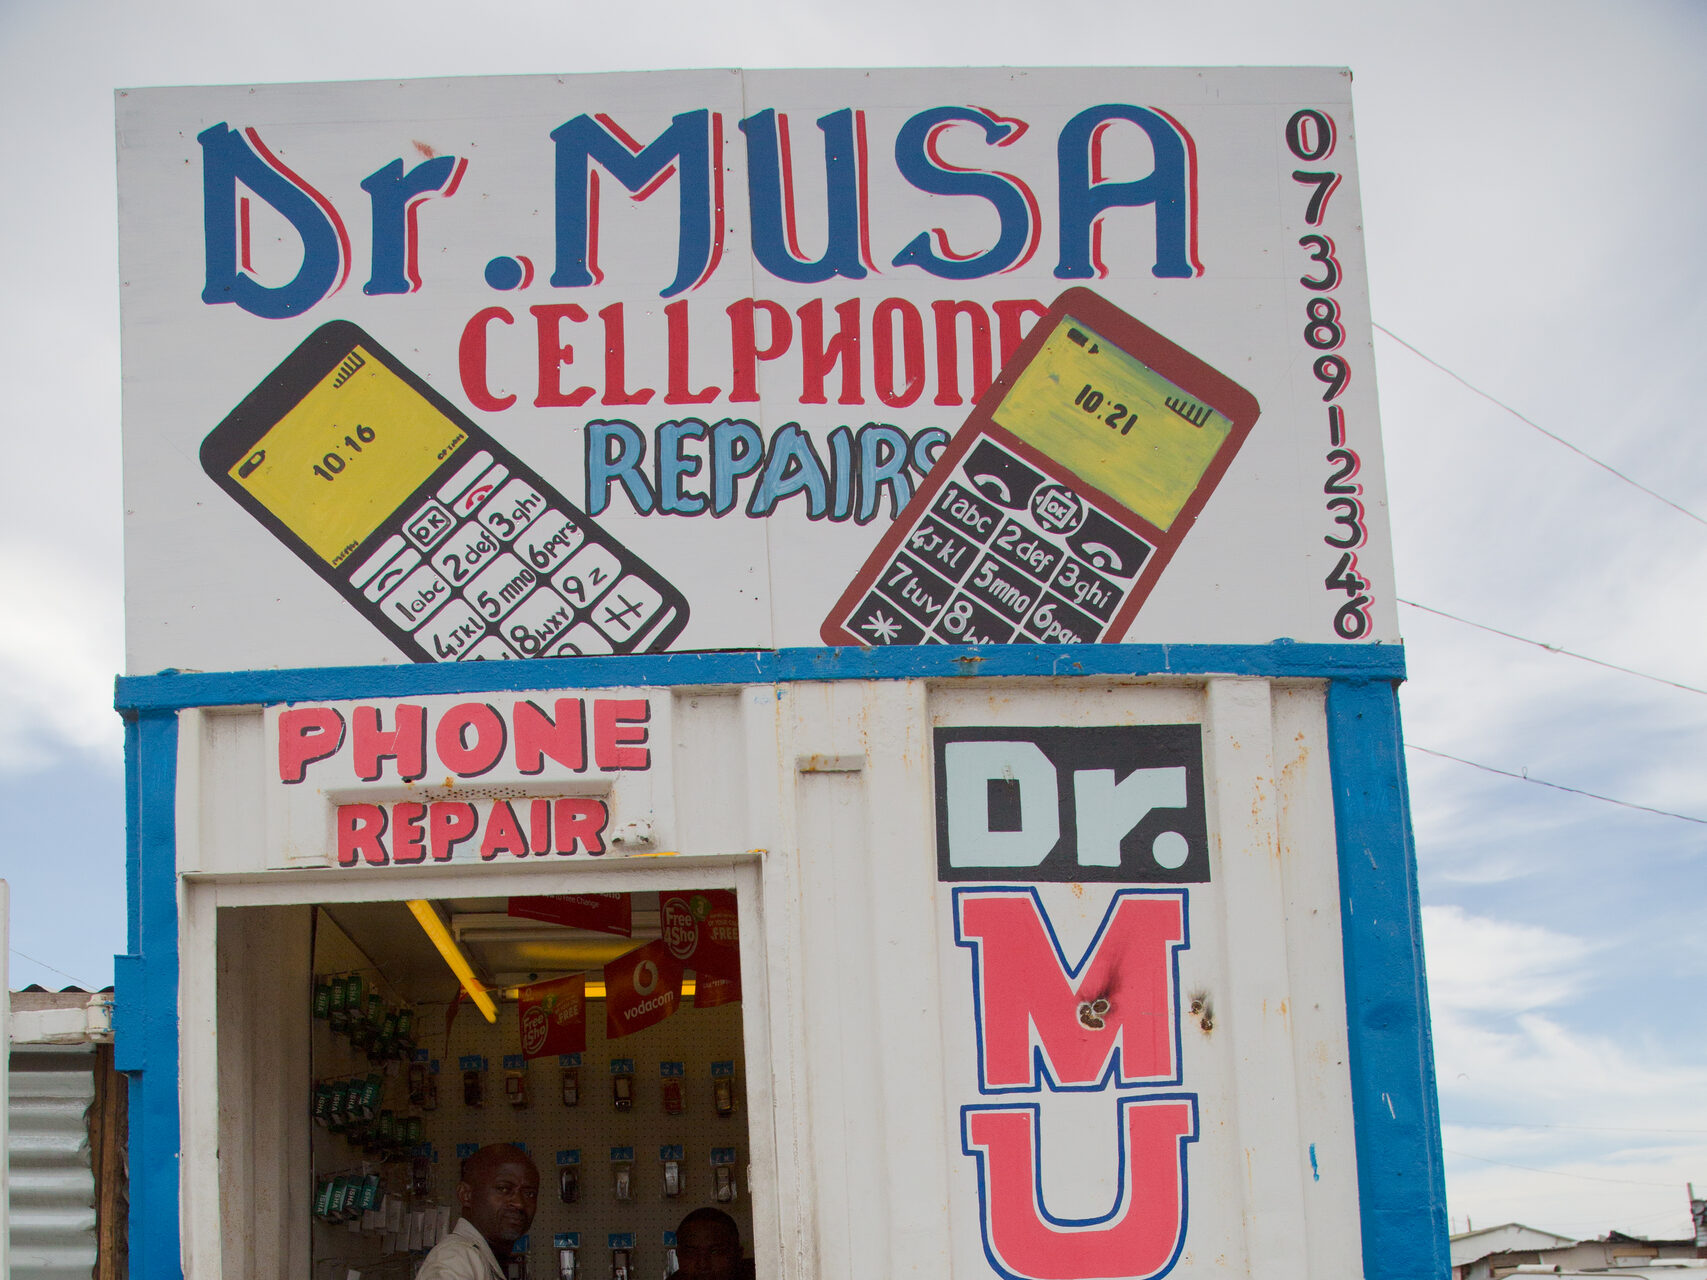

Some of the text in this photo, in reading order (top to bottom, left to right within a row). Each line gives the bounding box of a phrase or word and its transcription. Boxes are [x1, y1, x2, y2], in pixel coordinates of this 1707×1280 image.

[416, 514, 444, 539] OK
[940, 489, 992, 533] 1abc
[1047, 501, 1067, 518] OK
[442, 531, 497, 582] 2def
[996, 526, 1053, 573] 2def
[888, 561, 941, 614] 7tuv
[974, 560, 1030, 613] 5mno
[1058, 563, 1110, 609] 3ghi
[279, 698, 651, 784] PHONE
[945, 741, 1189, 869] Dr.
[337, 798, 609, 867] REPAIR
[664, 927, 695, 945] 4Sho
[666, 907, 692, 927] Free
[624, 989, 674, 1021] vodacom
